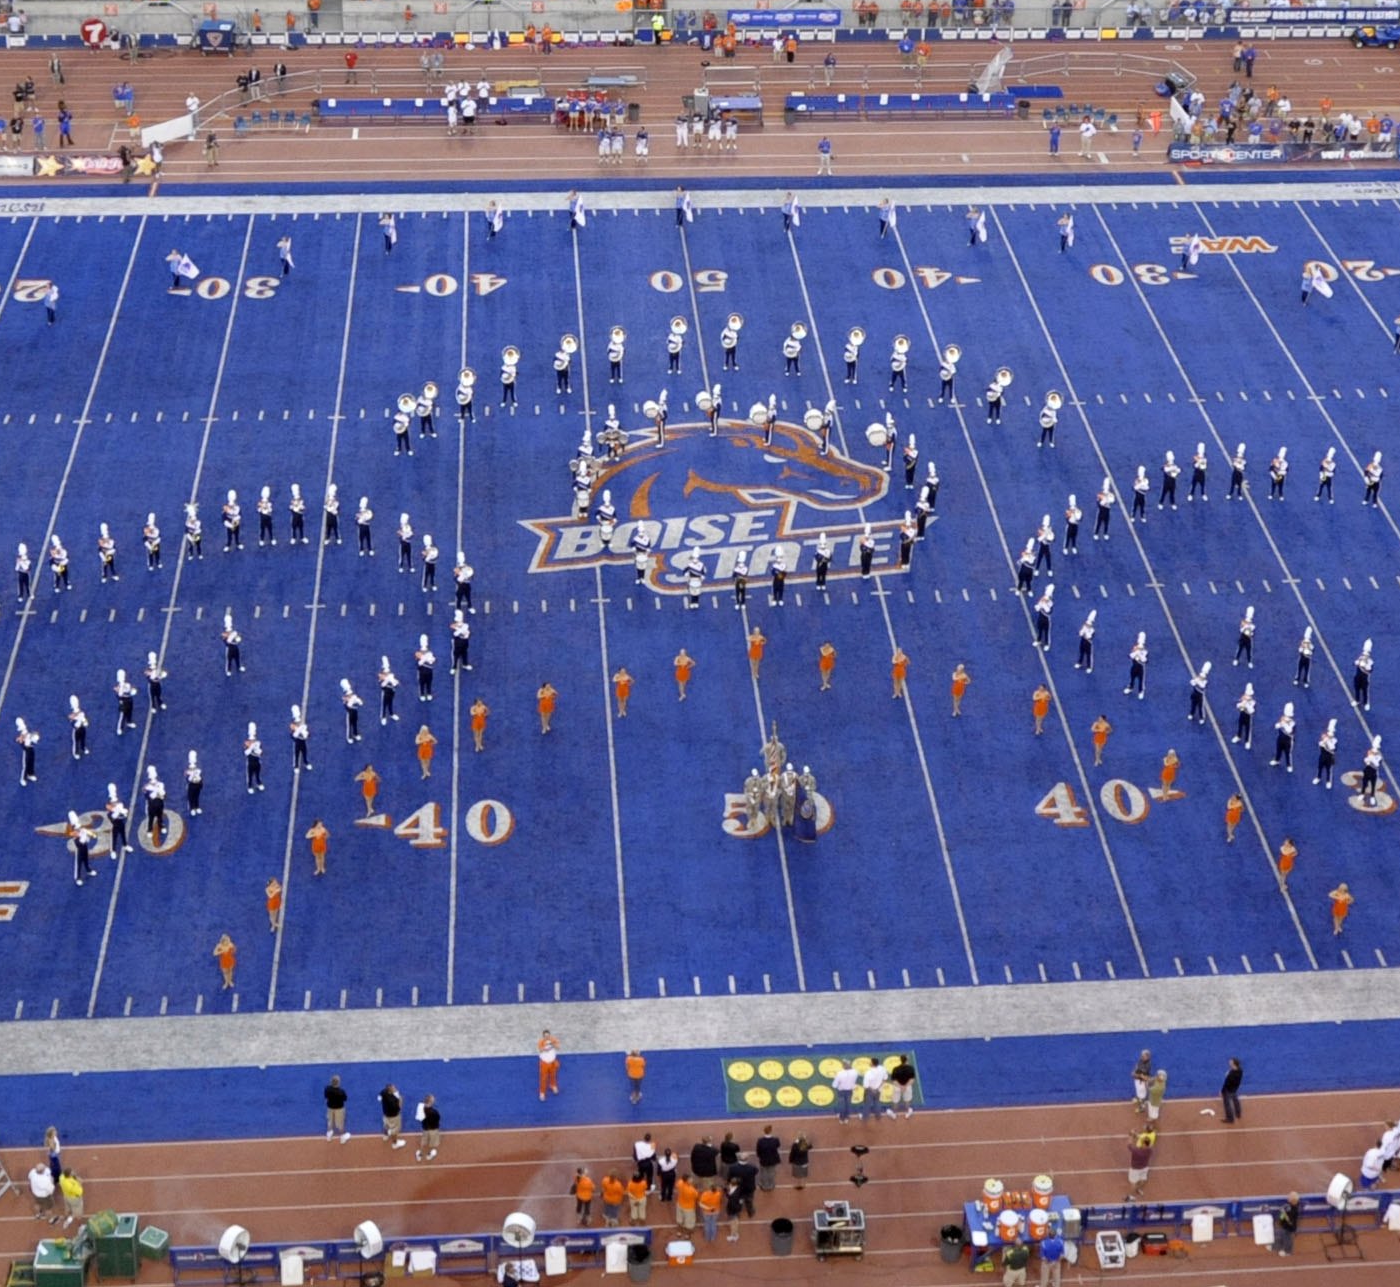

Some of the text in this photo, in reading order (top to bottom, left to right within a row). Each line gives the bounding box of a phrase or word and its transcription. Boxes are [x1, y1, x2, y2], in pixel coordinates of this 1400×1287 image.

[1308, 11, 1344, 21] NATION'S
[1346, 10, 1365, 20] NEW
[1366, 10, 1399, 20] STATION
[84, 22, 103, 43] 7
[1171, 149, 1281, 159] SPORTSCENTER
[425, 273, 508, 297] 40
[650, 270, 728, 293] 50
[872, 266, 953, 289] 40
[1090, 264, 1169, 286] 30
[198, 276, 281, 300] 30
[553, 510, 777, 560] BOISE
[666, 532, 893, 583] STATE
[1035, 779, 1151, 826] 40
[393, 798, 515, 847] 40
